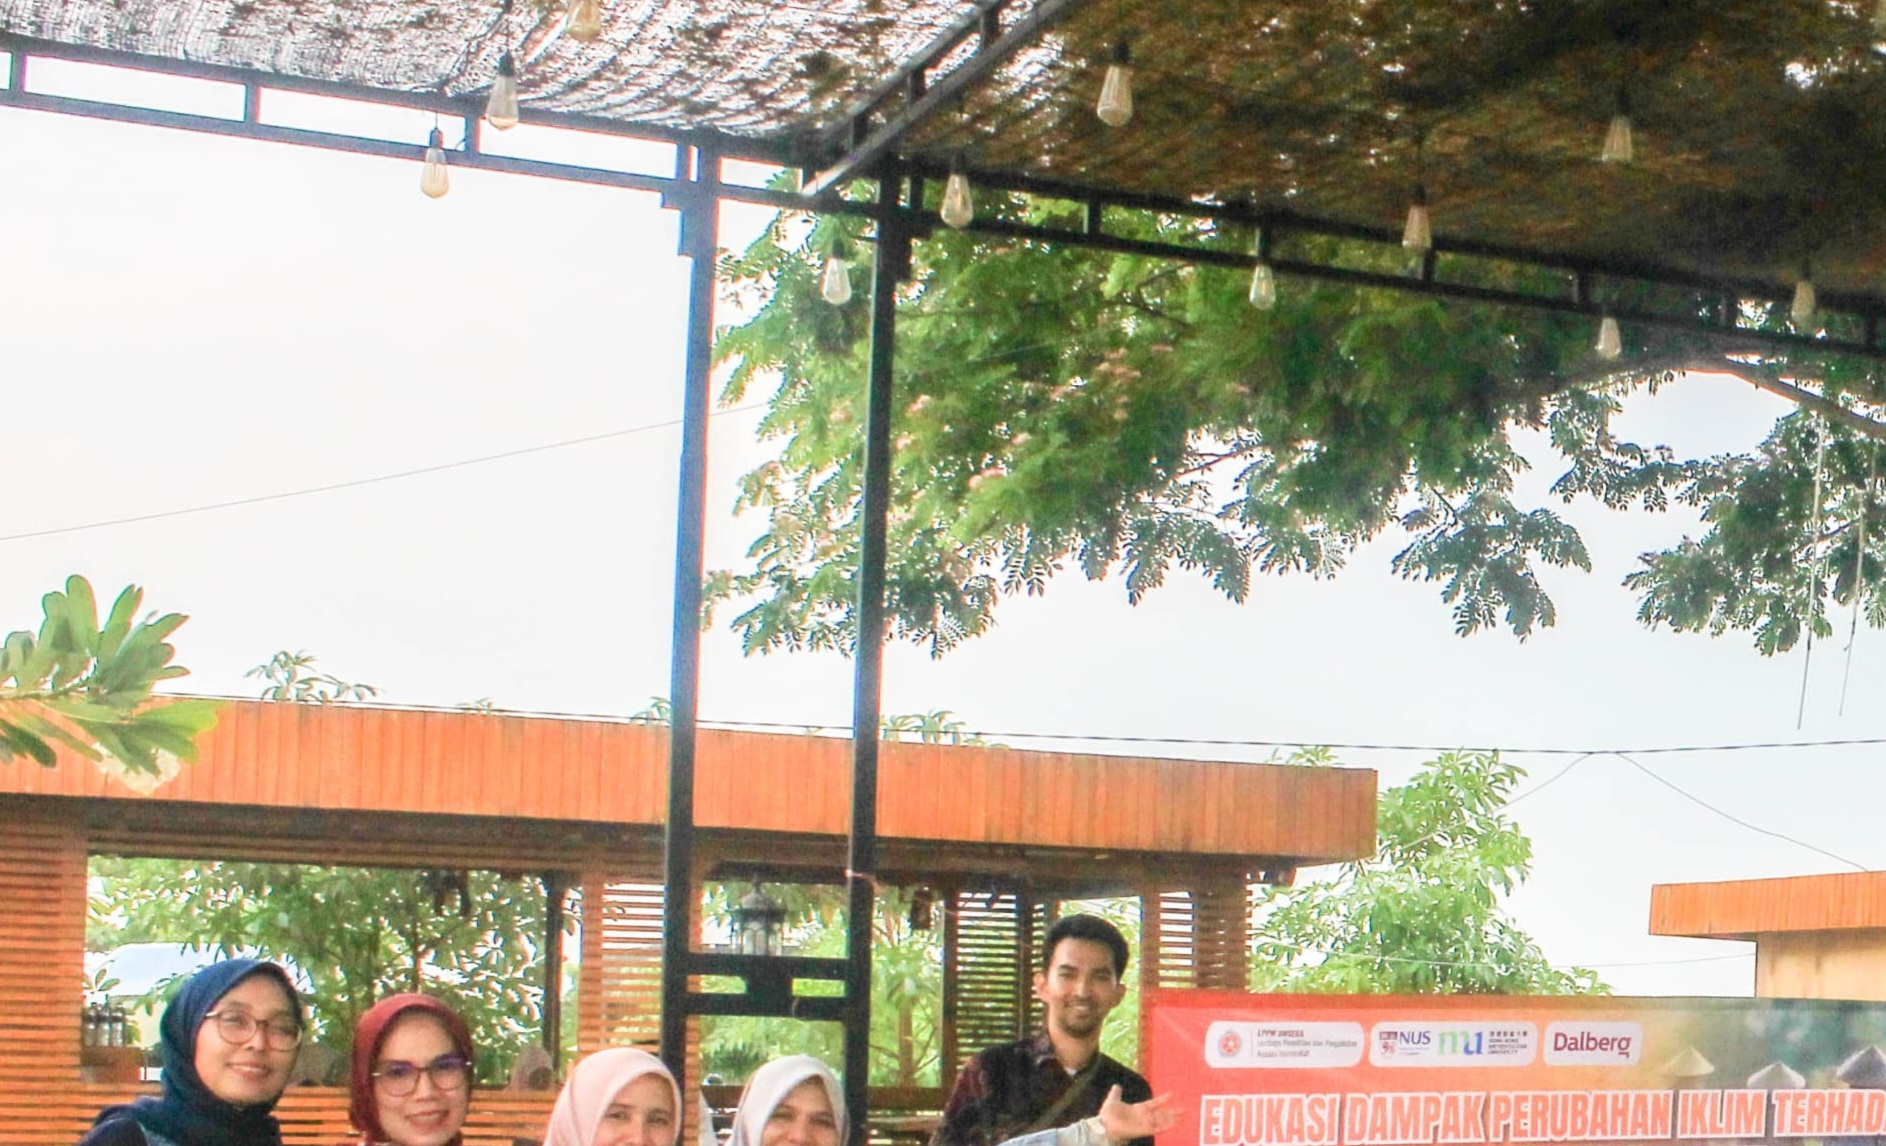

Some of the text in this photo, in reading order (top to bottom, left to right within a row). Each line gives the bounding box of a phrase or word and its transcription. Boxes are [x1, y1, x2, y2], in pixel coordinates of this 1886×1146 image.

[1399, 1030, 1431, 1045] NUS
[1553, 1032, 1632, 1058] Dalberg
[1344, 1091, 1486, 1146] DAMPAK
[1490, 1089, 1673, 1142] PERUBAHAN
[1677, 1089, 1768, 1138] IKLIM
